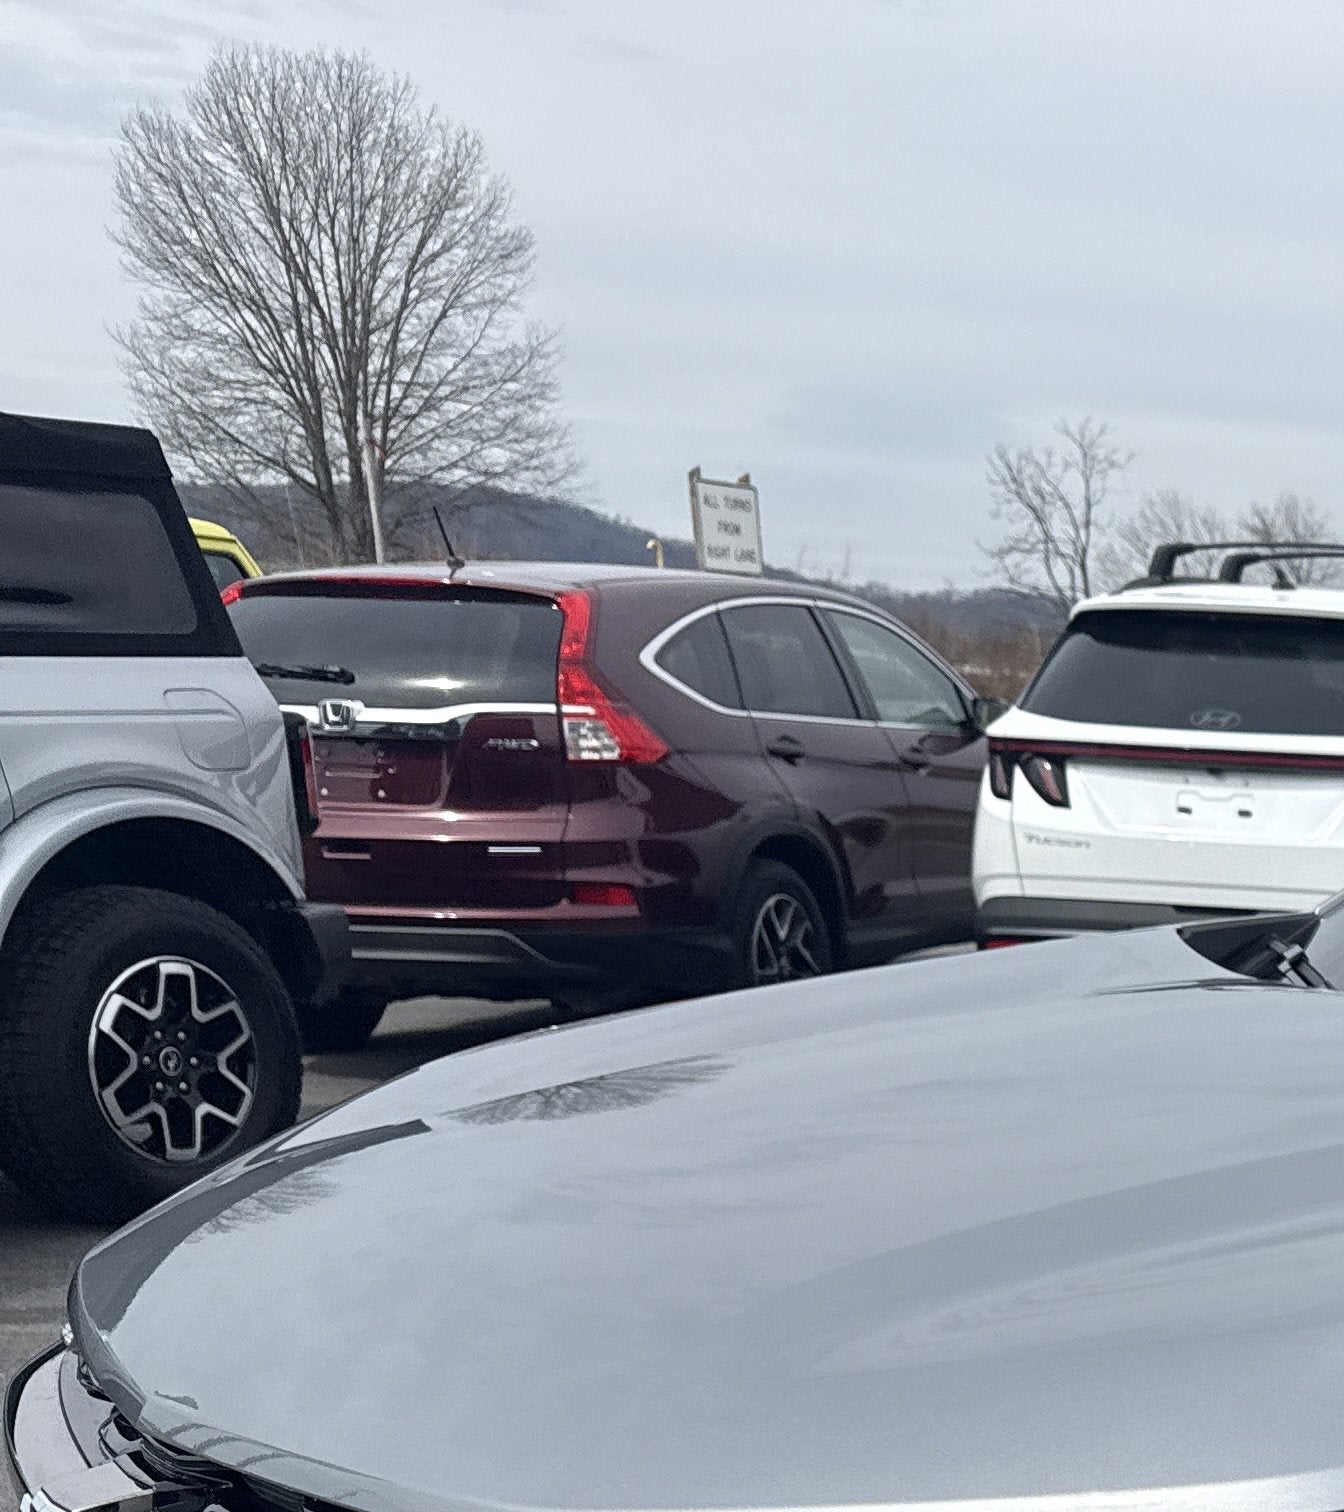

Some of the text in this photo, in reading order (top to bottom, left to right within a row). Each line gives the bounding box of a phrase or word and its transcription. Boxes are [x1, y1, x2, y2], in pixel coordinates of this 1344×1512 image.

[703, 493, 752, 513] ALL TURNS
[717, 519, 742, 537] FROM
[706, 543, 757, 563] RIGHT LANE
